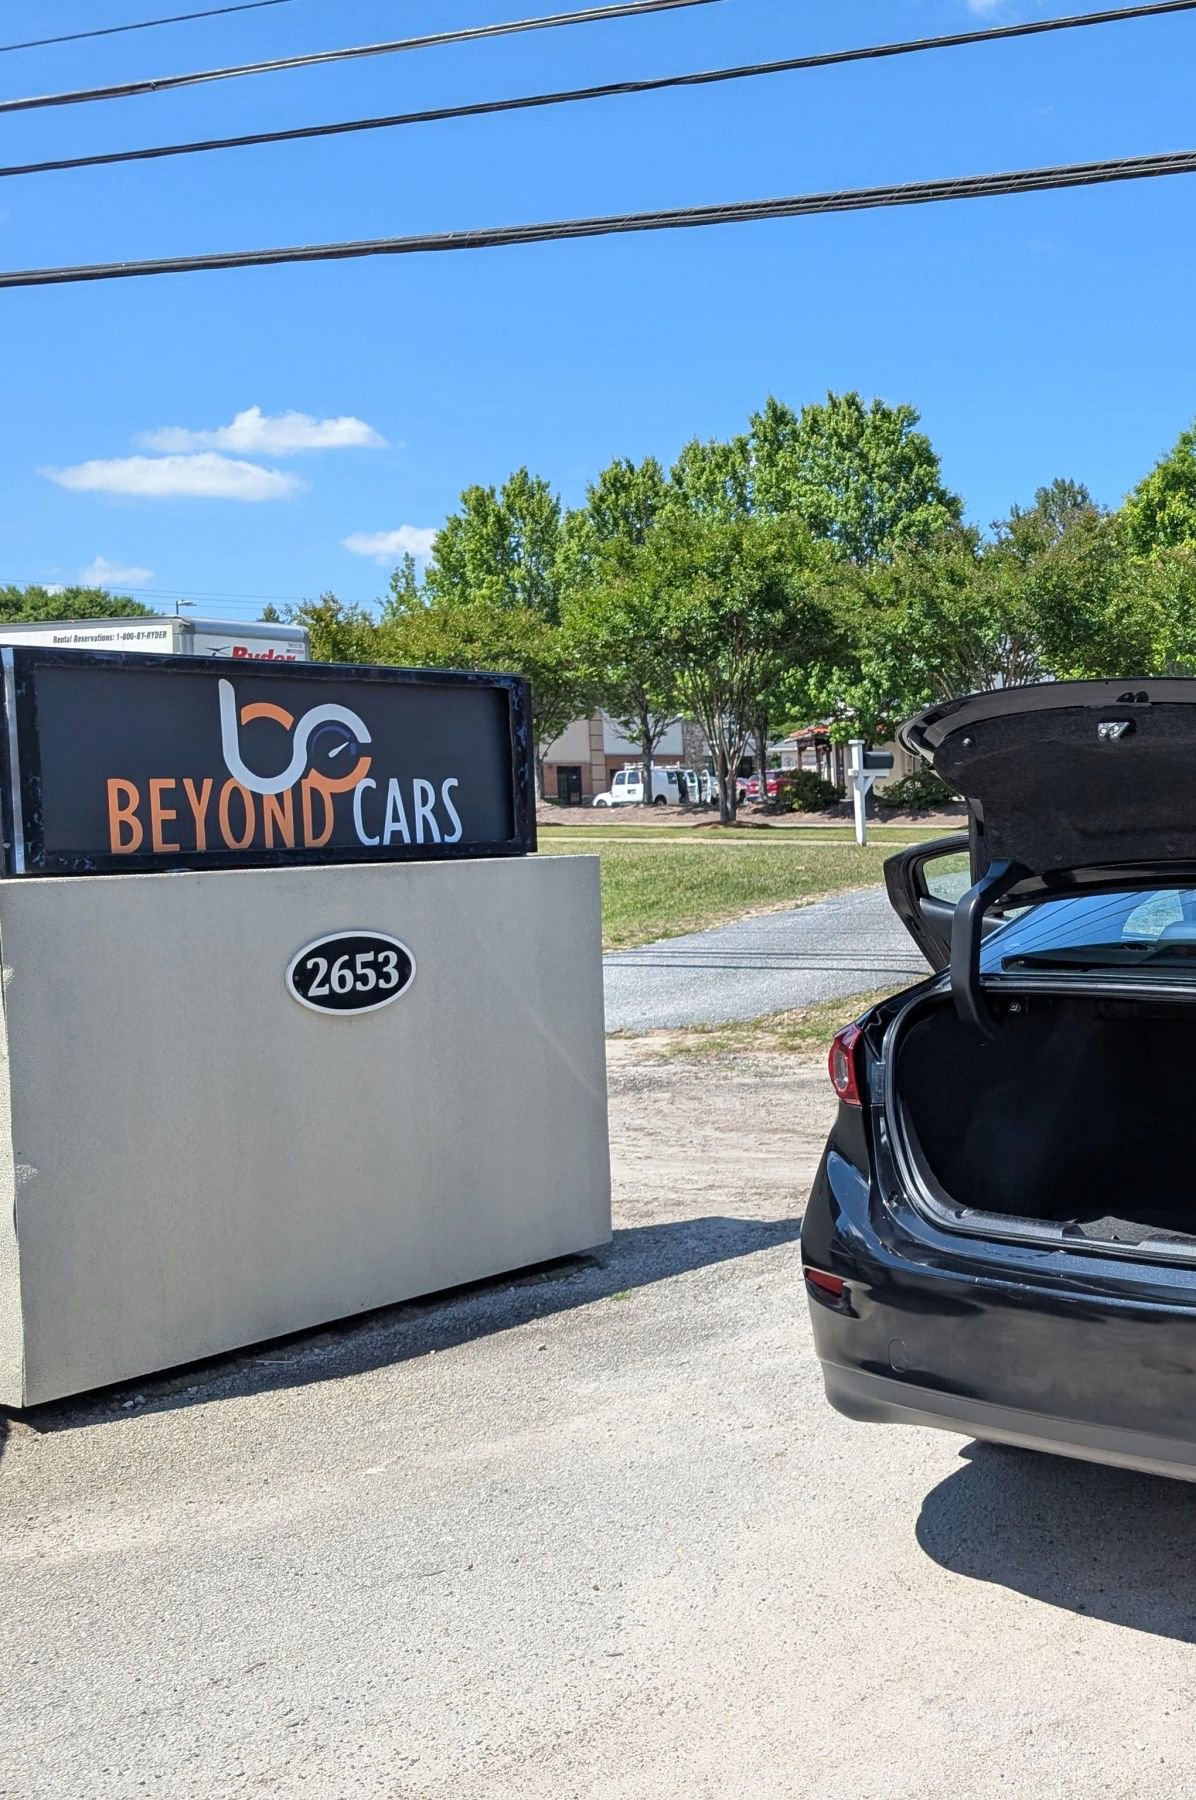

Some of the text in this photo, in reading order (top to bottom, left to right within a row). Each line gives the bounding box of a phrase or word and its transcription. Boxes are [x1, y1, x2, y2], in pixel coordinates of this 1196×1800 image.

[53, 630, 167, 644] Rental Reservations: 1-800-BY-RYDER
[107, 777, 463, 854] BEYOND CARS
[306, 950, 399, 997] 2653
